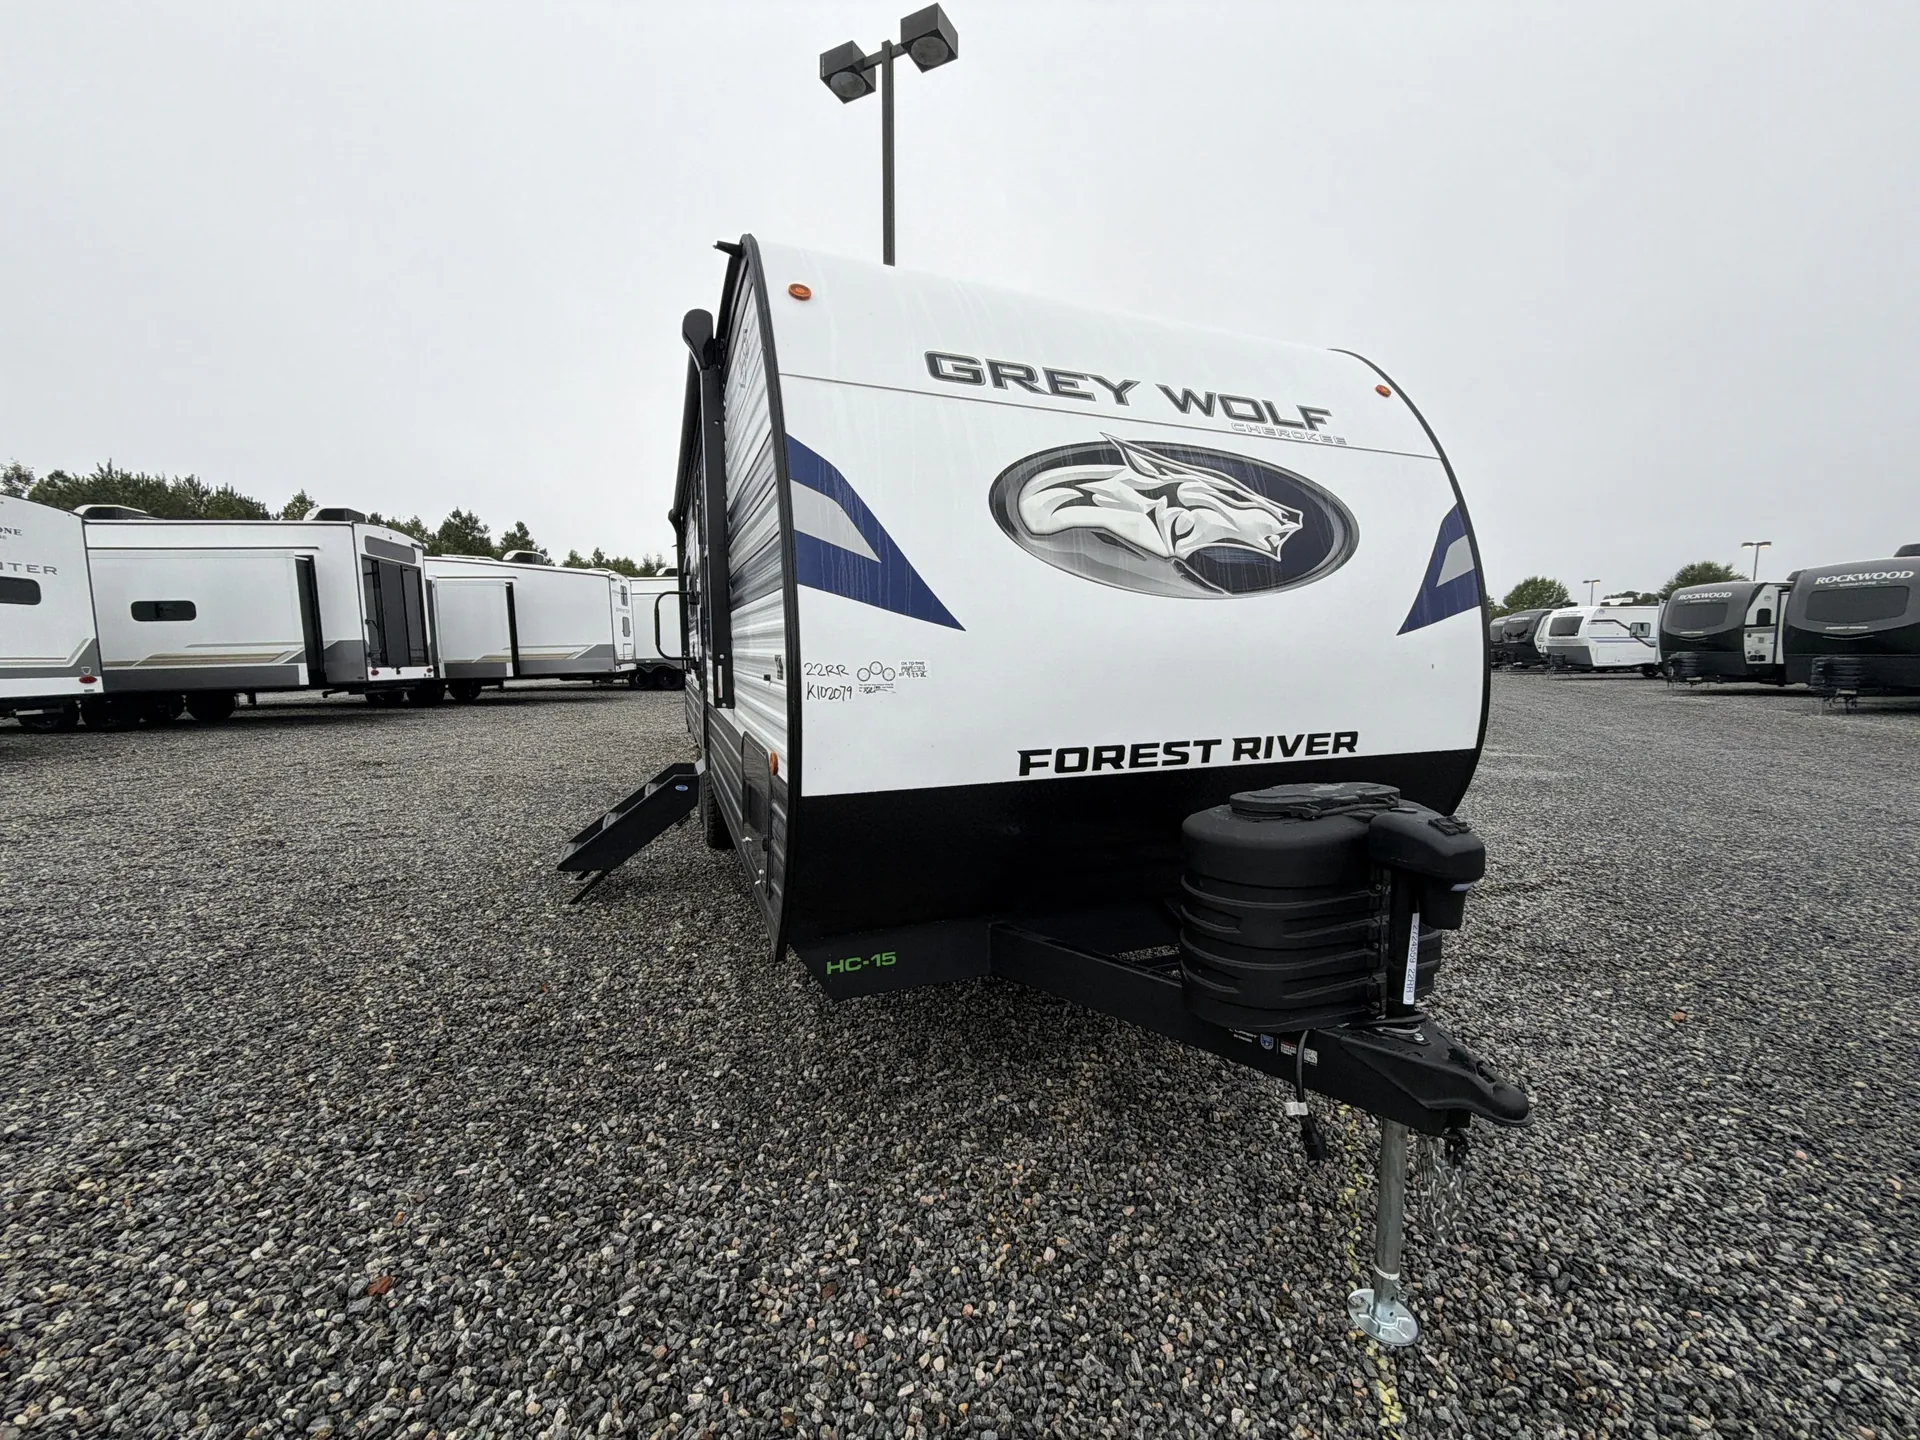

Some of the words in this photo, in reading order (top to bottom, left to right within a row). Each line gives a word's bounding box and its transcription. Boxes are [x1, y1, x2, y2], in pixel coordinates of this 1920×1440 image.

[924, 350, 1141, 406] GREY
[1155, 383, 1332, 431] WOLF
[1231, 422, 1348, 445] CHEROKEE
[0, 561, 58, 575] TER
[1814, 570, 1915, 585] ROCKWOOD
[1678, 591, 1733, 601] ROCKWOOD
[803, 662, 850, 677] 22RR
[806, 681, 853, 701] K102079
[1018, 738, 1223, 776] FOREST
[1232, 731, 1359, 763] RIVER
[826, 951, 897, 975] HC-15
